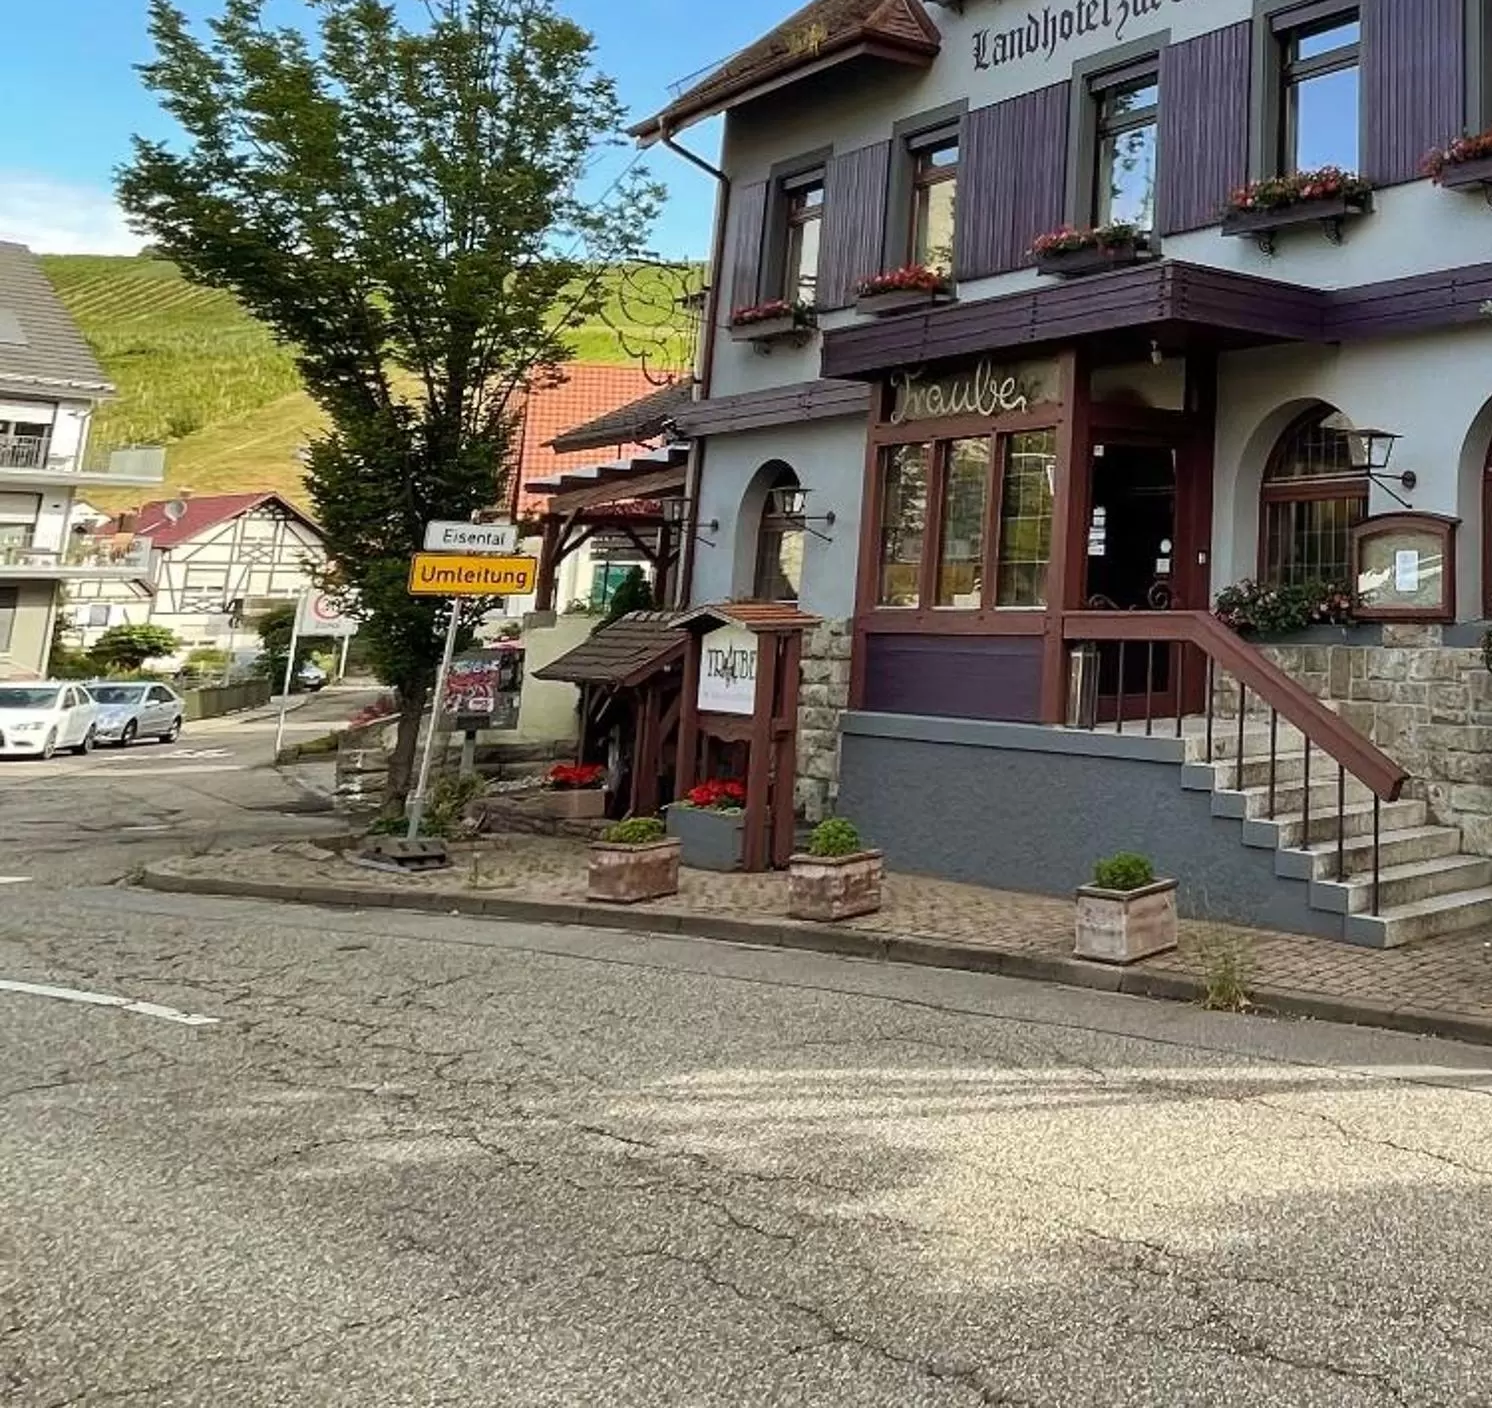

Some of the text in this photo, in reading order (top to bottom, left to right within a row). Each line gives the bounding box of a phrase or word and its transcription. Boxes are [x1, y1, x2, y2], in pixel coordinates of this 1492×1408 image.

[890, 358, 1027, 425] Traube
[443, 528, 506, 546] Eisental
[421, 565, 527, 589] Umleitung
